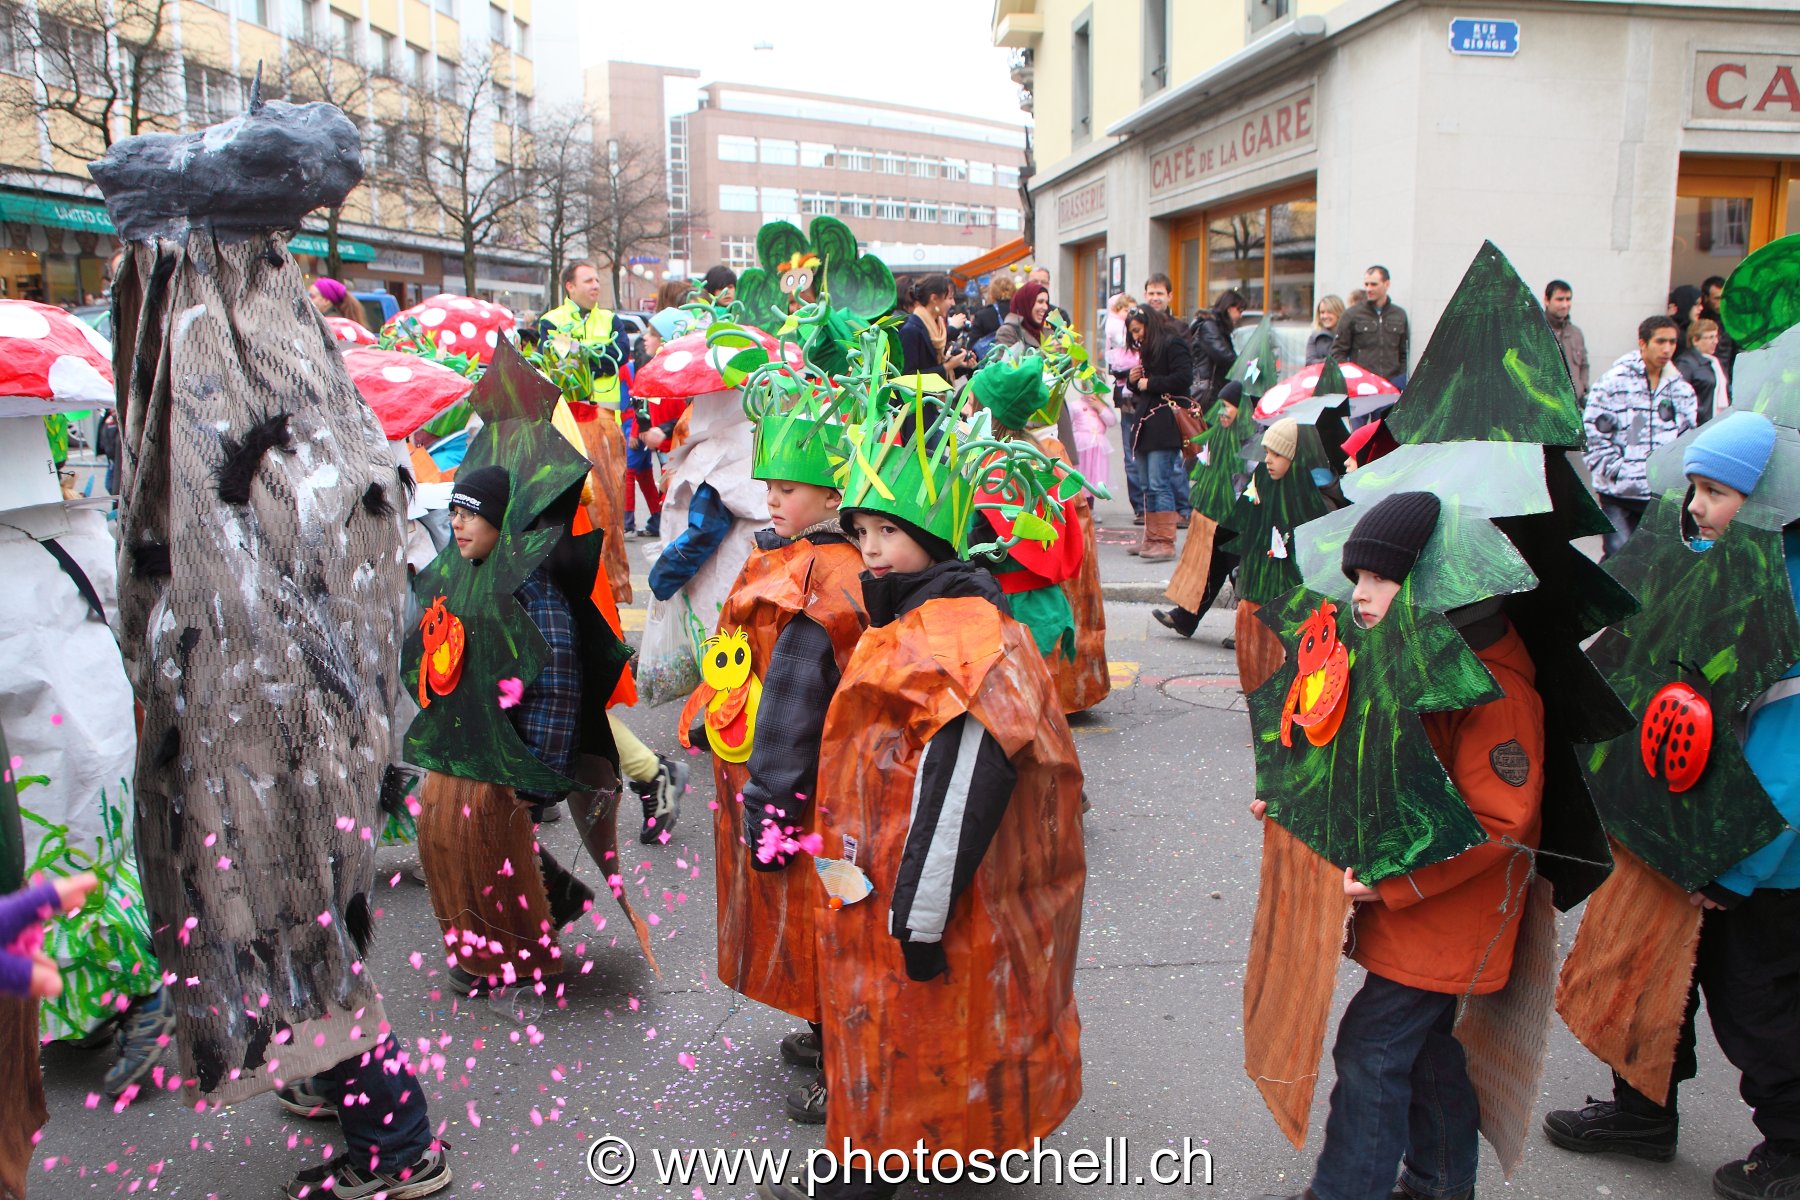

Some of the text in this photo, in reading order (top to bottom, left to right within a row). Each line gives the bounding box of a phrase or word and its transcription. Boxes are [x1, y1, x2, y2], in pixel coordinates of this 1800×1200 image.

[1473, 23, 1497, 34] RUE
[1706, 63, 1800, 112] CA
[1152, 97, 1313, 189] CAFÉ DE LA GARE
[54, 206, 95, 223] UNITED
[1060, 183, 1105, 222] BRASSERIE
